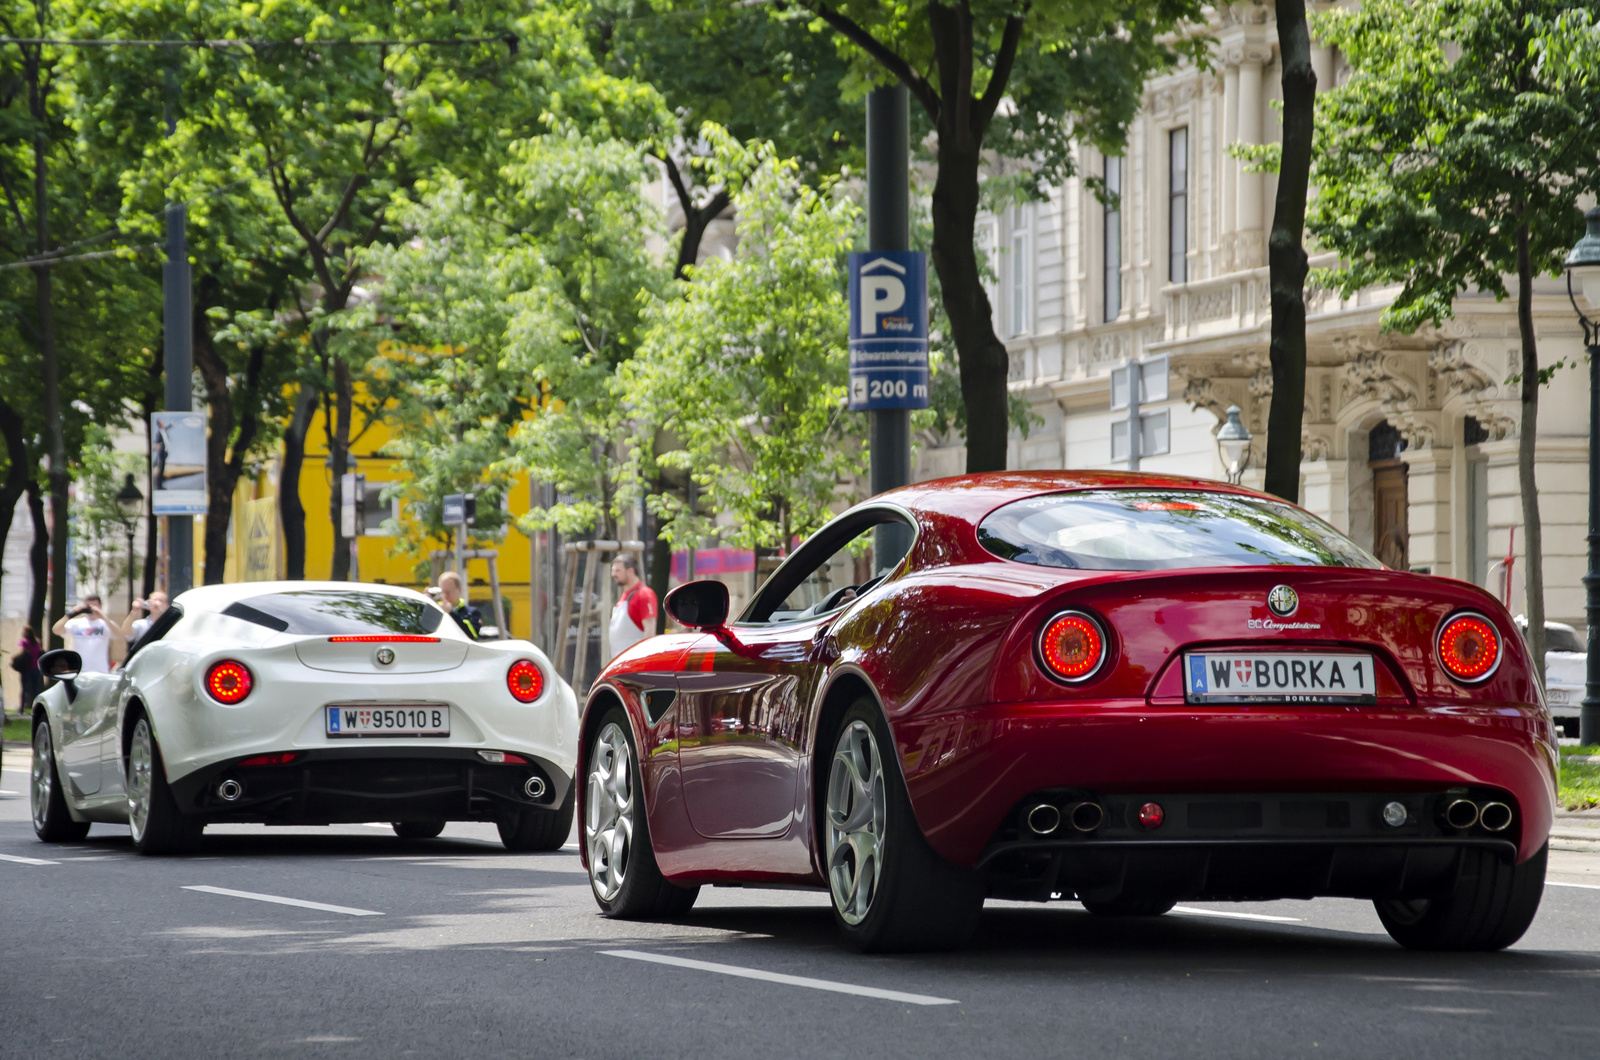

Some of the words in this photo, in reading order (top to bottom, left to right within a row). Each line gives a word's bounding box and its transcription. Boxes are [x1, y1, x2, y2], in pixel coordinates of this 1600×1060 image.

[861, 275, 906, 335] P
[870, 380, 907, 398] 200
[913, 385, 928, 398] m
[1263, 619, 1321, 631] Competizione
[1196, 679, 1204, 688] A
[1211, 660, 1231, 689] W
[1254, 660, 1345, 689] BORKA
[1353, 661, 1364, 689] 1
[344, 710, 358, 728] W
[373, 710, 426, 728] 95010
[432, 710, 442, 728] B
